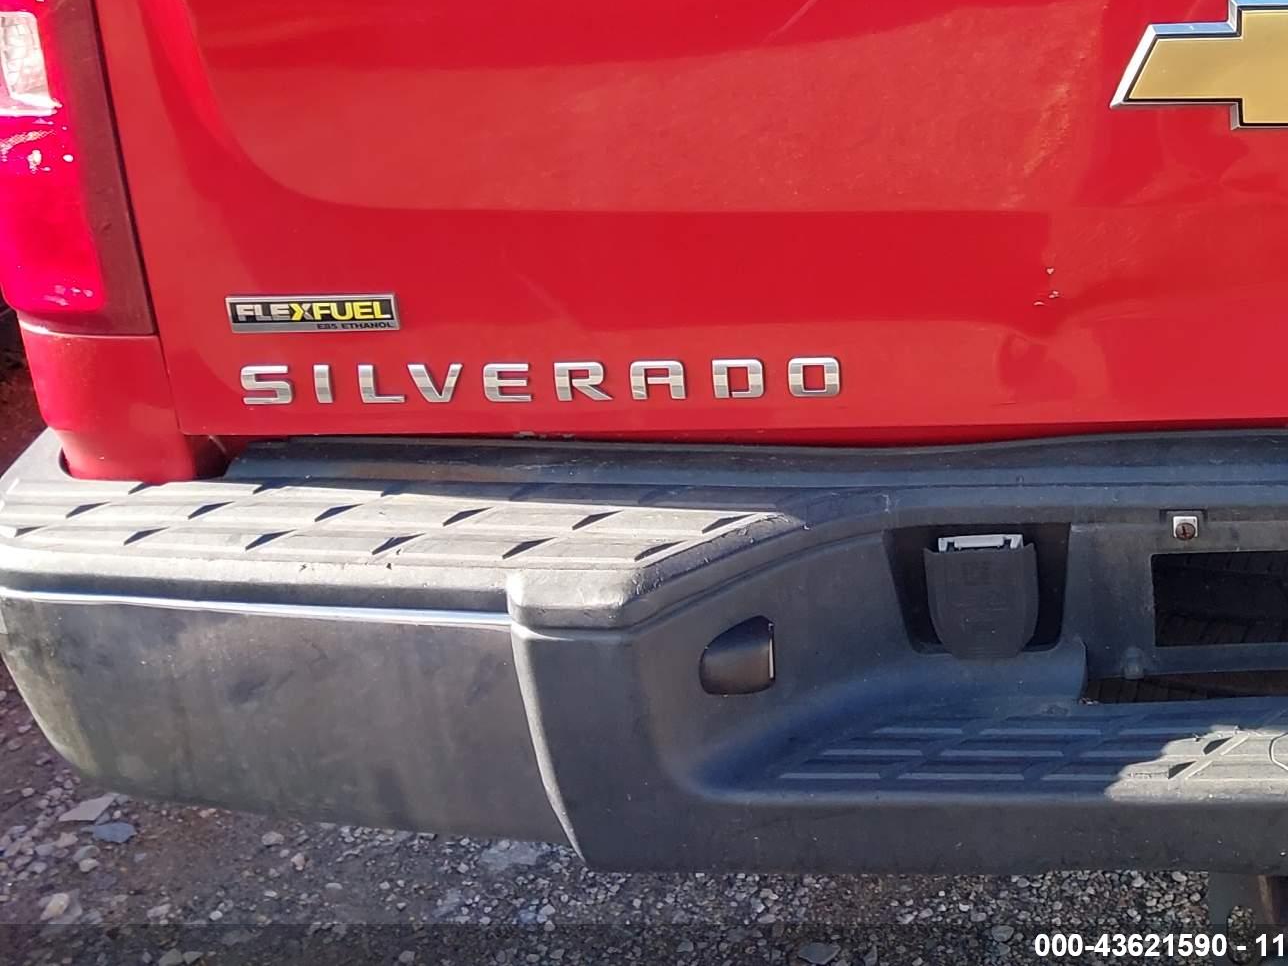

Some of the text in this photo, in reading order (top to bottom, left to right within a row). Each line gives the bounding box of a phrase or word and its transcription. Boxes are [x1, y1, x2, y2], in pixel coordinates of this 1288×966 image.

[235, 301, 392, 322] FLEXFUEL
[316, 320, 394, 330] E85 ETHANOL
[240, 356, 841, 406] SILVERADO
